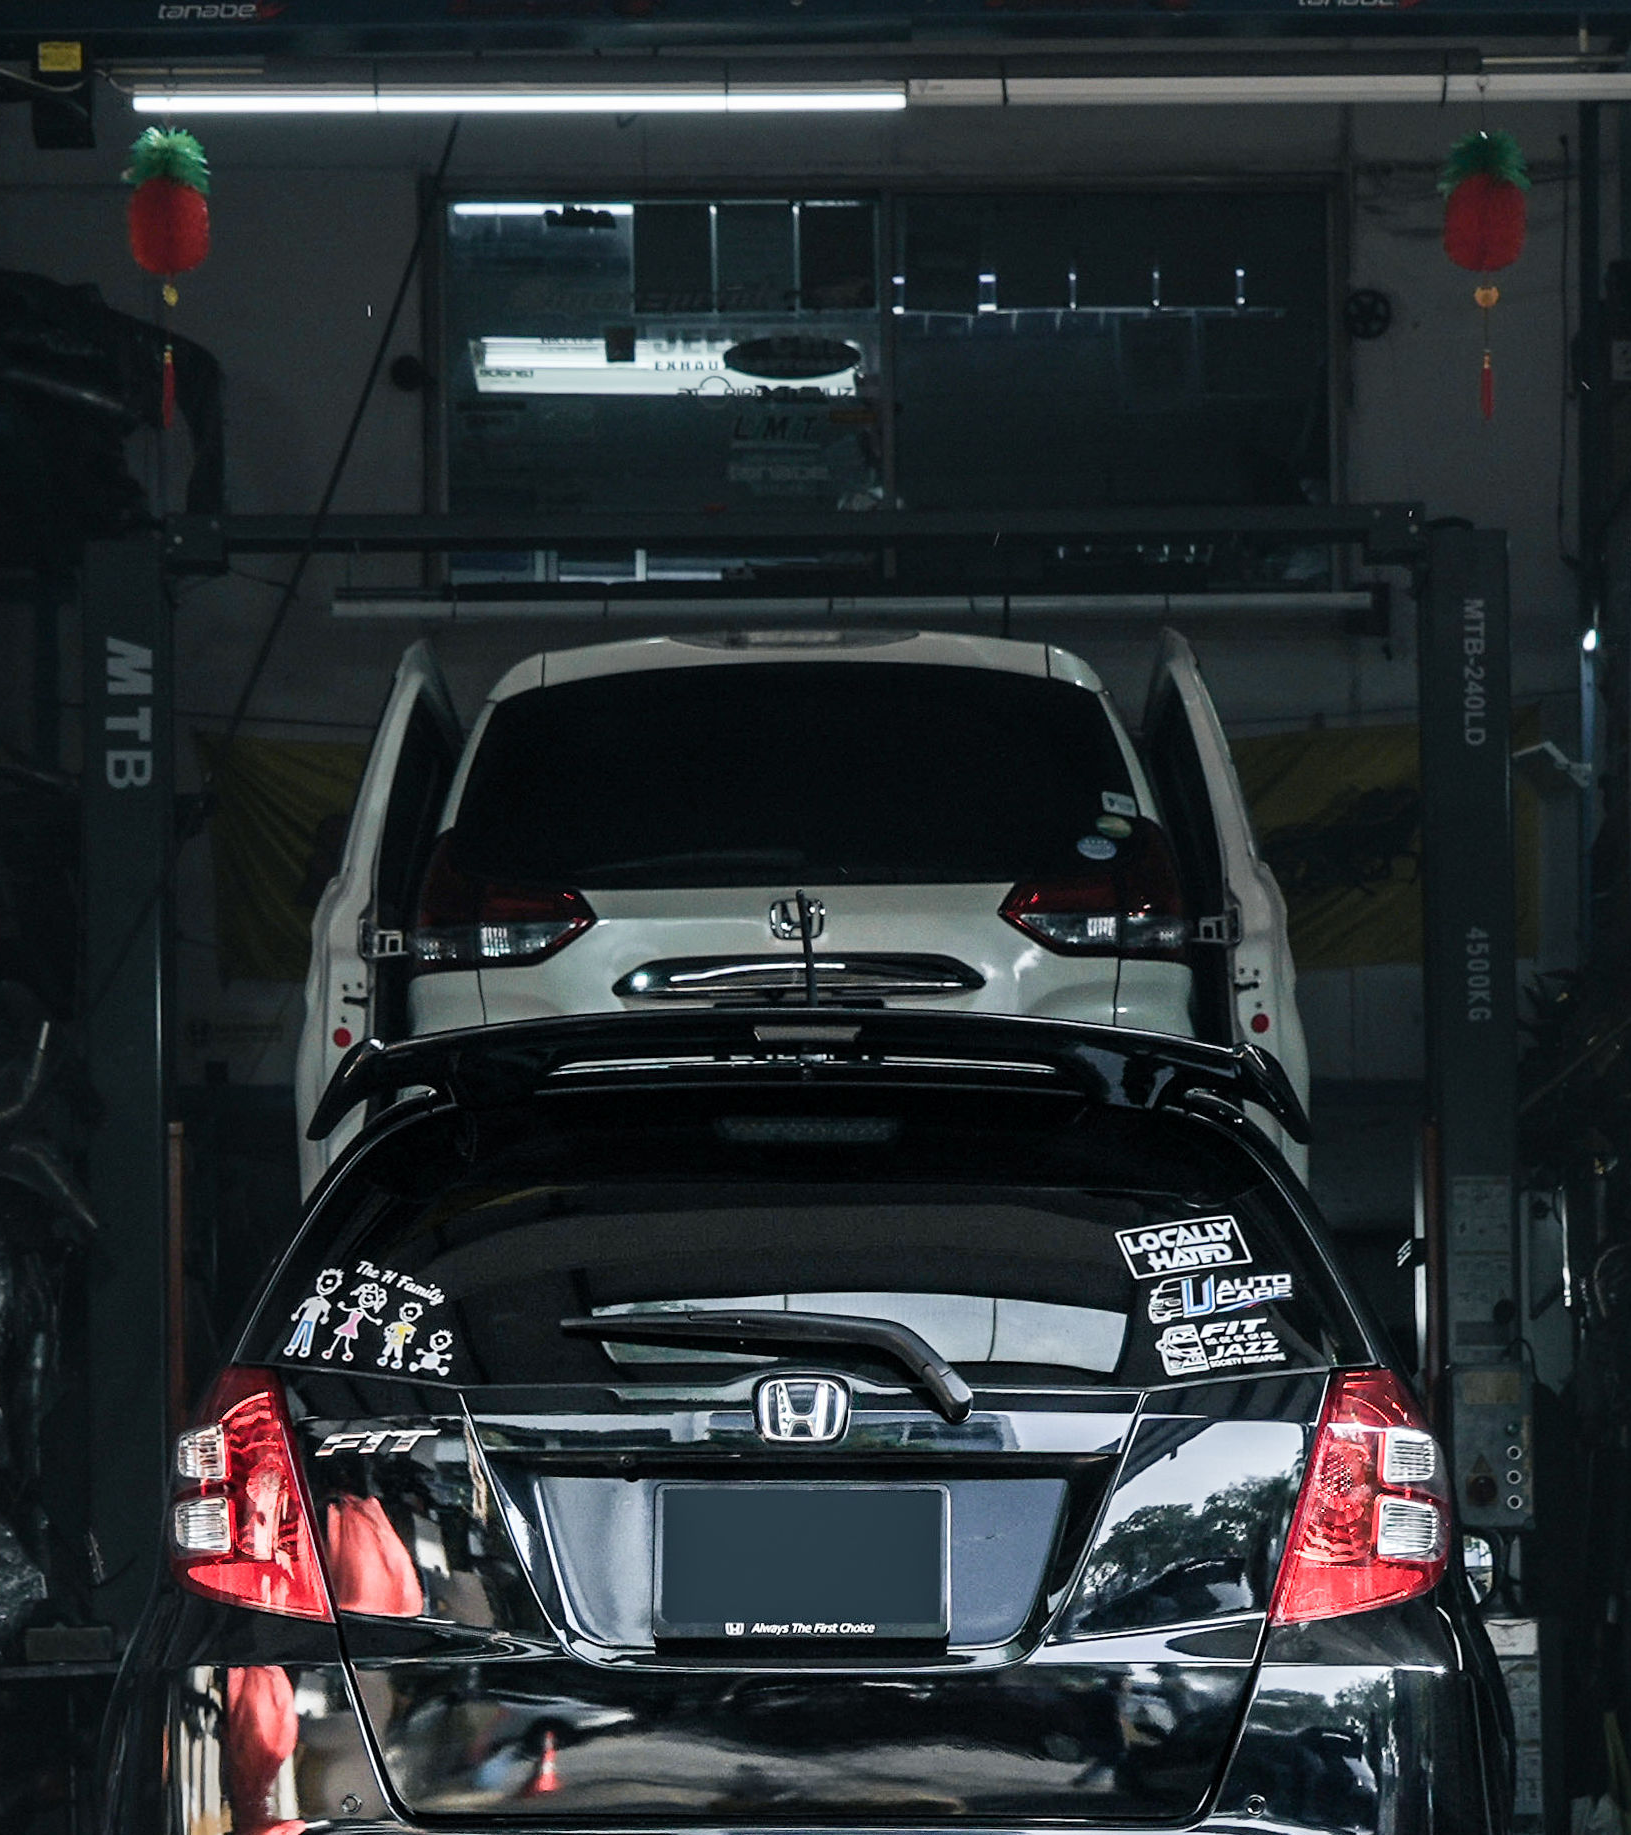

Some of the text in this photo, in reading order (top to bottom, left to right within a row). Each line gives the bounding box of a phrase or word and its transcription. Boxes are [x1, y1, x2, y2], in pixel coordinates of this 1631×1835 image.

[157, 3, 257, 20] tanabe
[1462, 597, 1487, 747] MTB-240LD
[105, 635, 154, 790] MTB
[1465, 926, 1492, 1024] 4500KG
[1122, 1221, 1233, 1255] LOCALLY
[355, 1259, 379, 1280] The
[396, 1275, 447, 1307] Family
[1215, 1286, 1293, 1306] CARE
[1216, 1273, 1293, 1293] AUTO
[1200, 1317, 1268, 1339] FIT
[1208, 1339, 1280, 1361] JAZZ
[314, 1428, 443, 1458] FIT
[751, 1622, 876, 1636] Always The First Choice
